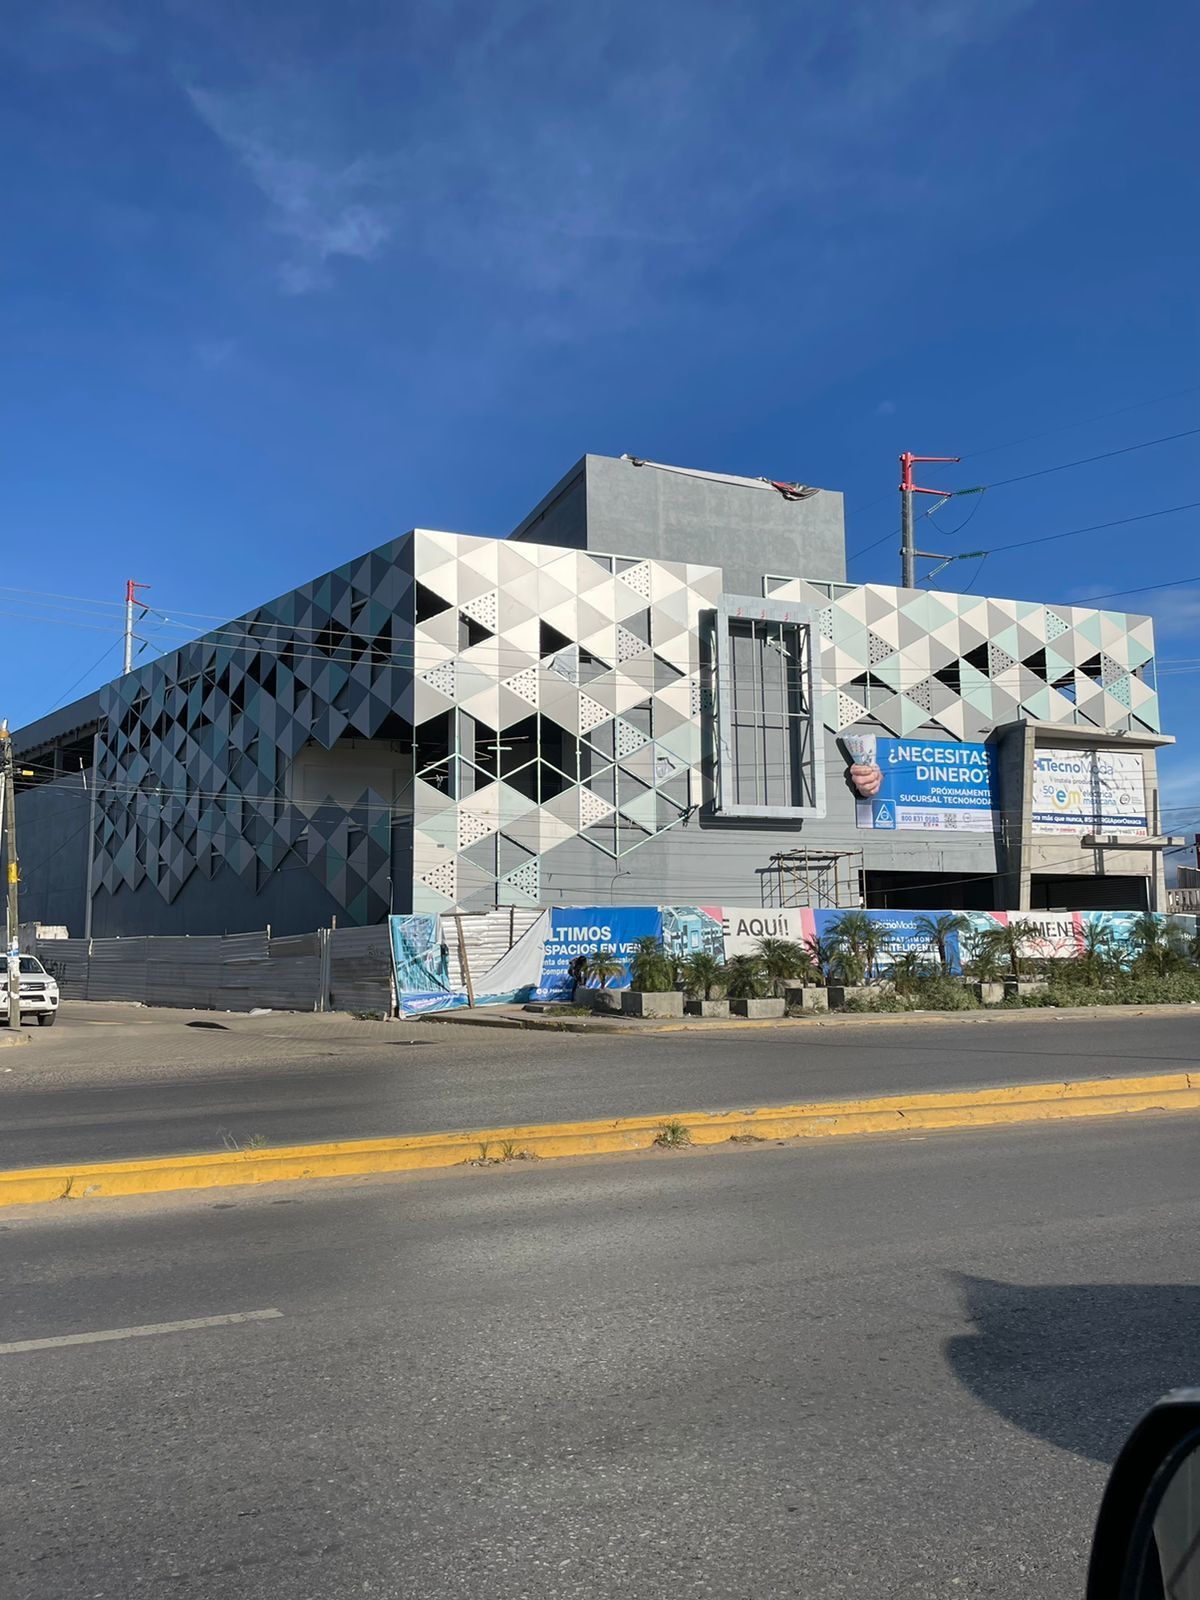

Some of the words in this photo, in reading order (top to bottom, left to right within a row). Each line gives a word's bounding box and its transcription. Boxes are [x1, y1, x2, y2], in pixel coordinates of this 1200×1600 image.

[888, 745, 992, 766] ¿NECESITAS
[1040, 758, 1114, 775] TecnoModa
[916, 765, 992, 784] DINERO?
[931, 787, 993, 797] PRÓXIMAMENTE
[899, 795, 942, 804] SUCURSAL
[944, 796, 994, 806] TECNOMODA
[736, 913, 789, 936] AQUÍ!
[600, 943, 617, 954] EN
